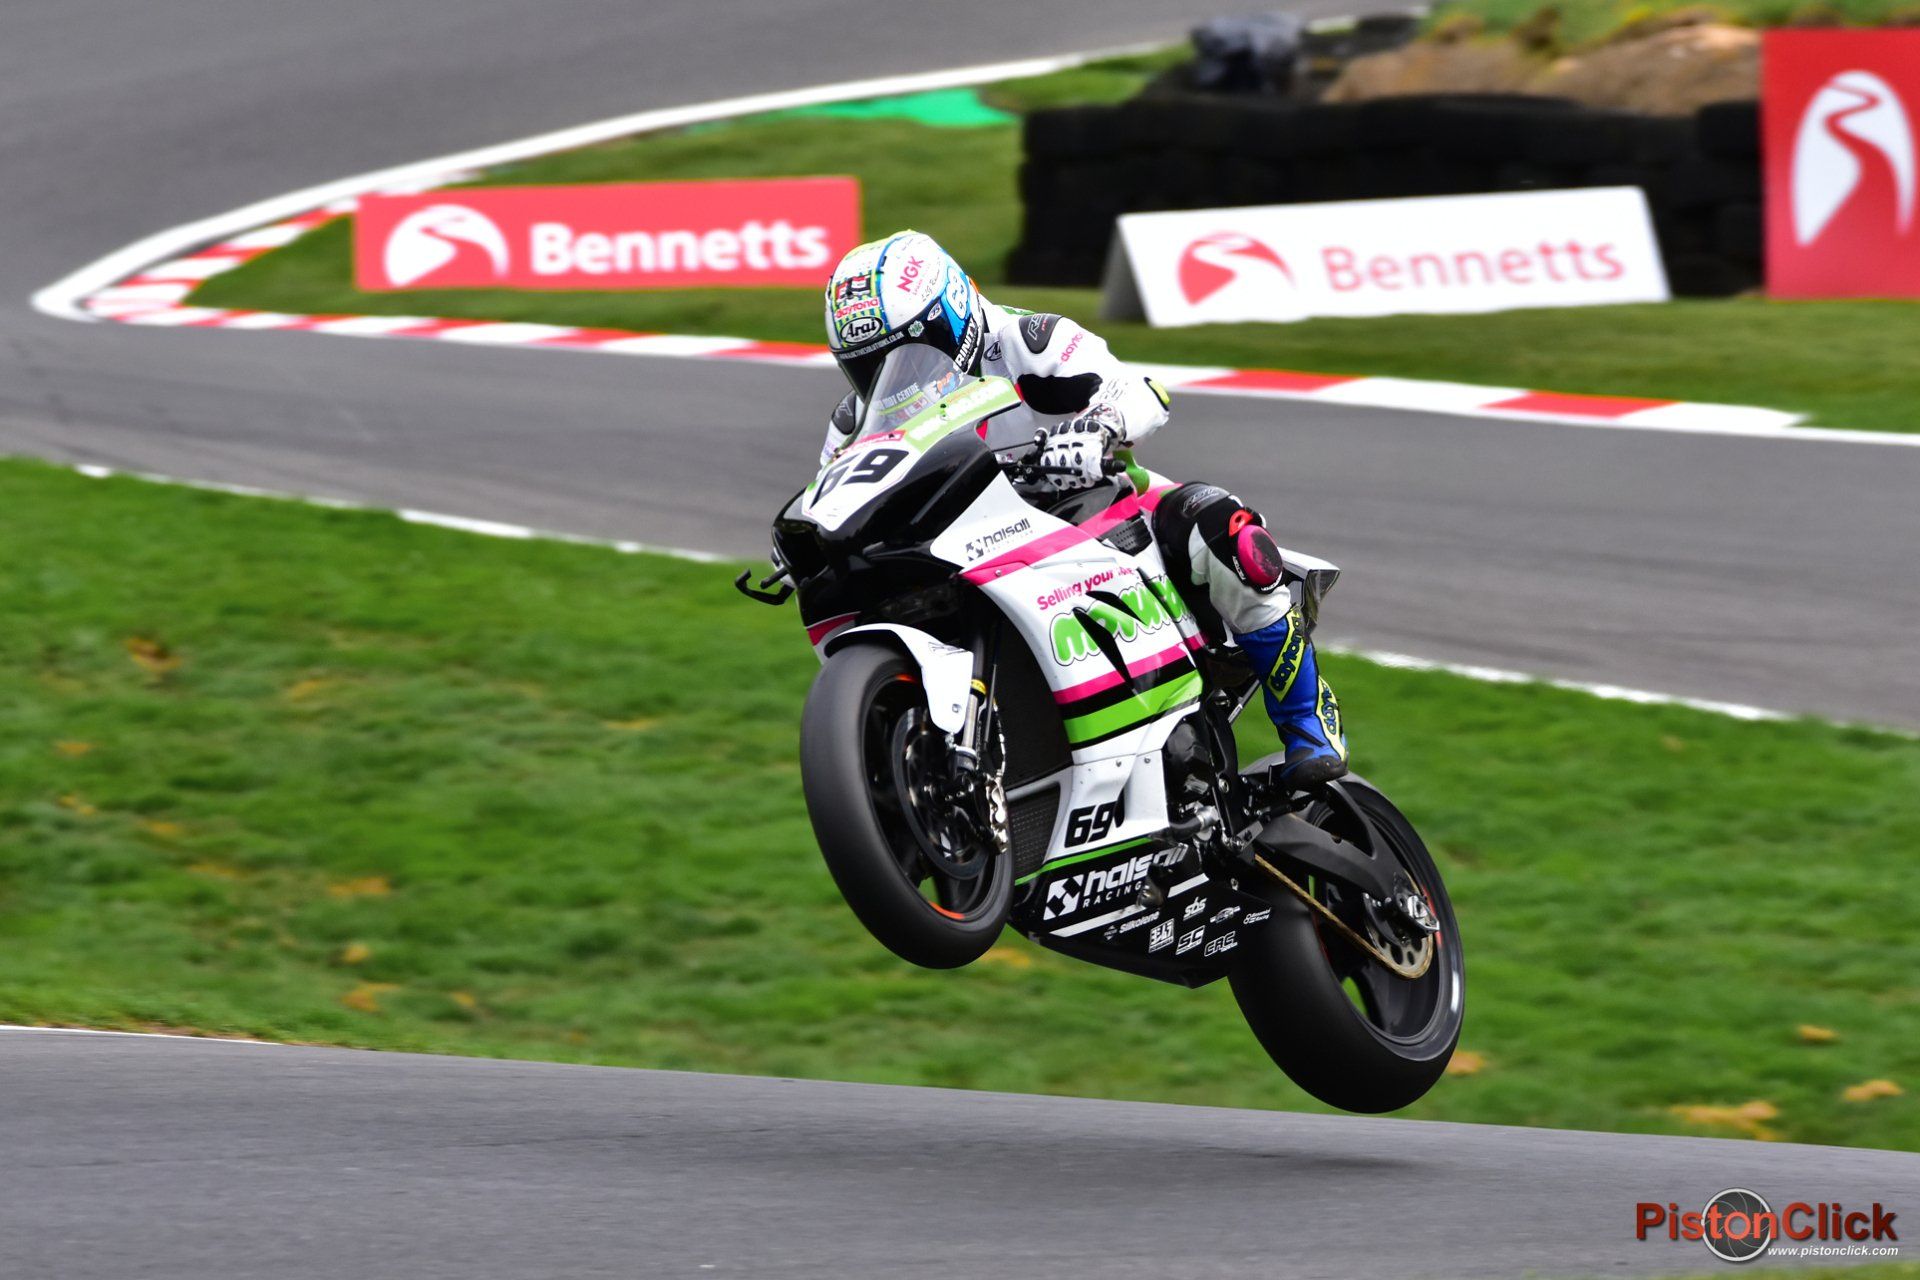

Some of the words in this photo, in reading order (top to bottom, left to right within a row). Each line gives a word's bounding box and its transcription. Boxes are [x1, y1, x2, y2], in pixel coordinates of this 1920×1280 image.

[530, 221, 829, 275] Bennetts
[1321, 241, 1623, 292] Bennetts
[897, 256, 924, 292] NGK
[846, 318, 877, 339] Arai
[808, 448, 910, 510] 69
[1036, 582, 1082, 611] Selling
[1085, 572, 1114, 591] your
[1064, 801, 1118, 848] 69
[1083, 881, 1142, 909] RACING
